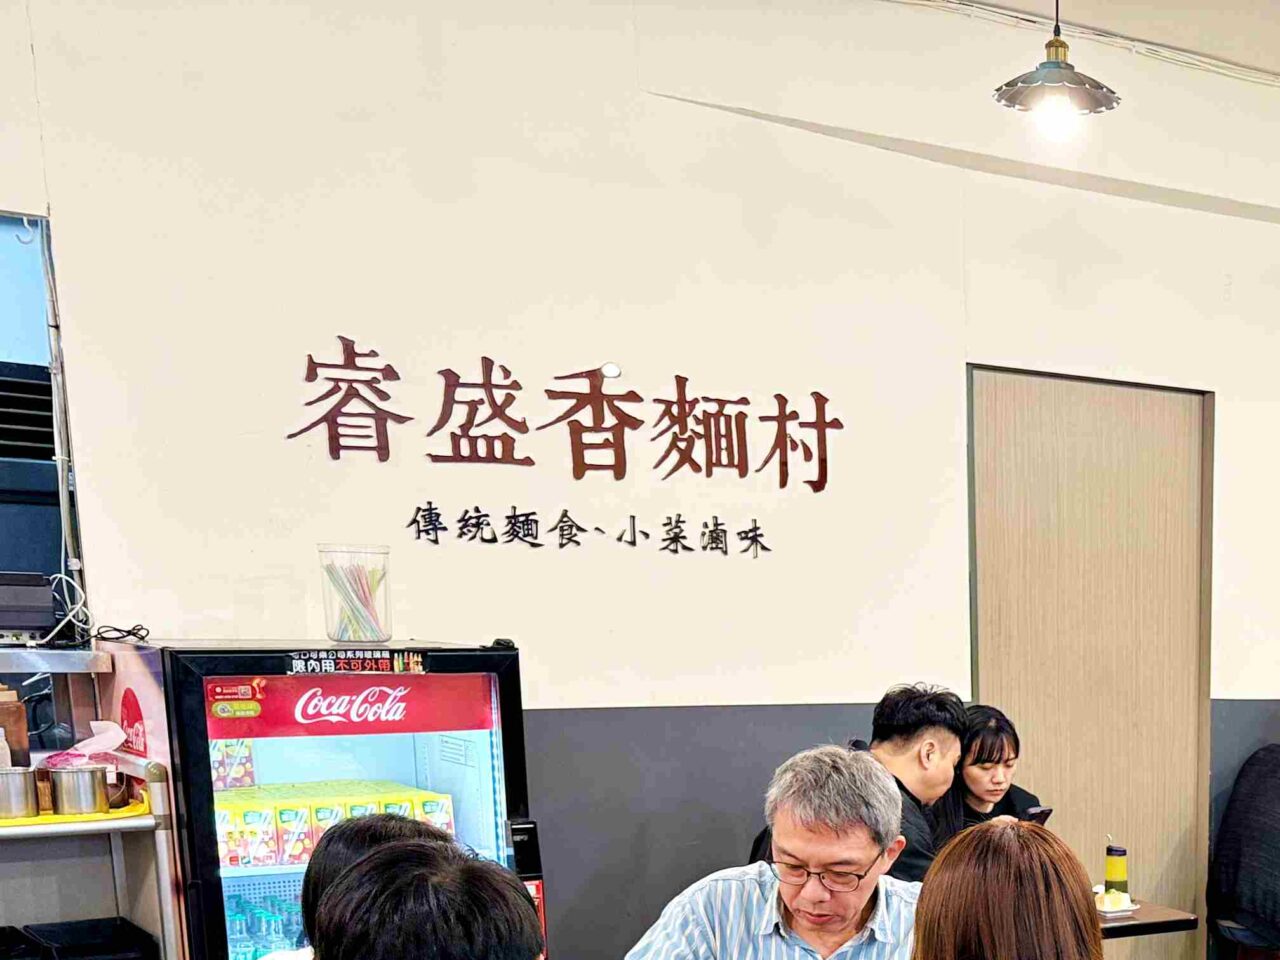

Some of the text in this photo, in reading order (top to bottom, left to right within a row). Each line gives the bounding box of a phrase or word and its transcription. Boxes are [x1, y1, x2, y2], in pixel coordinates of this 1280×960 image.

[287, 335, 844, 493] 睿盛香麵村
[294, 686, 412, 724] Coca-Cola
